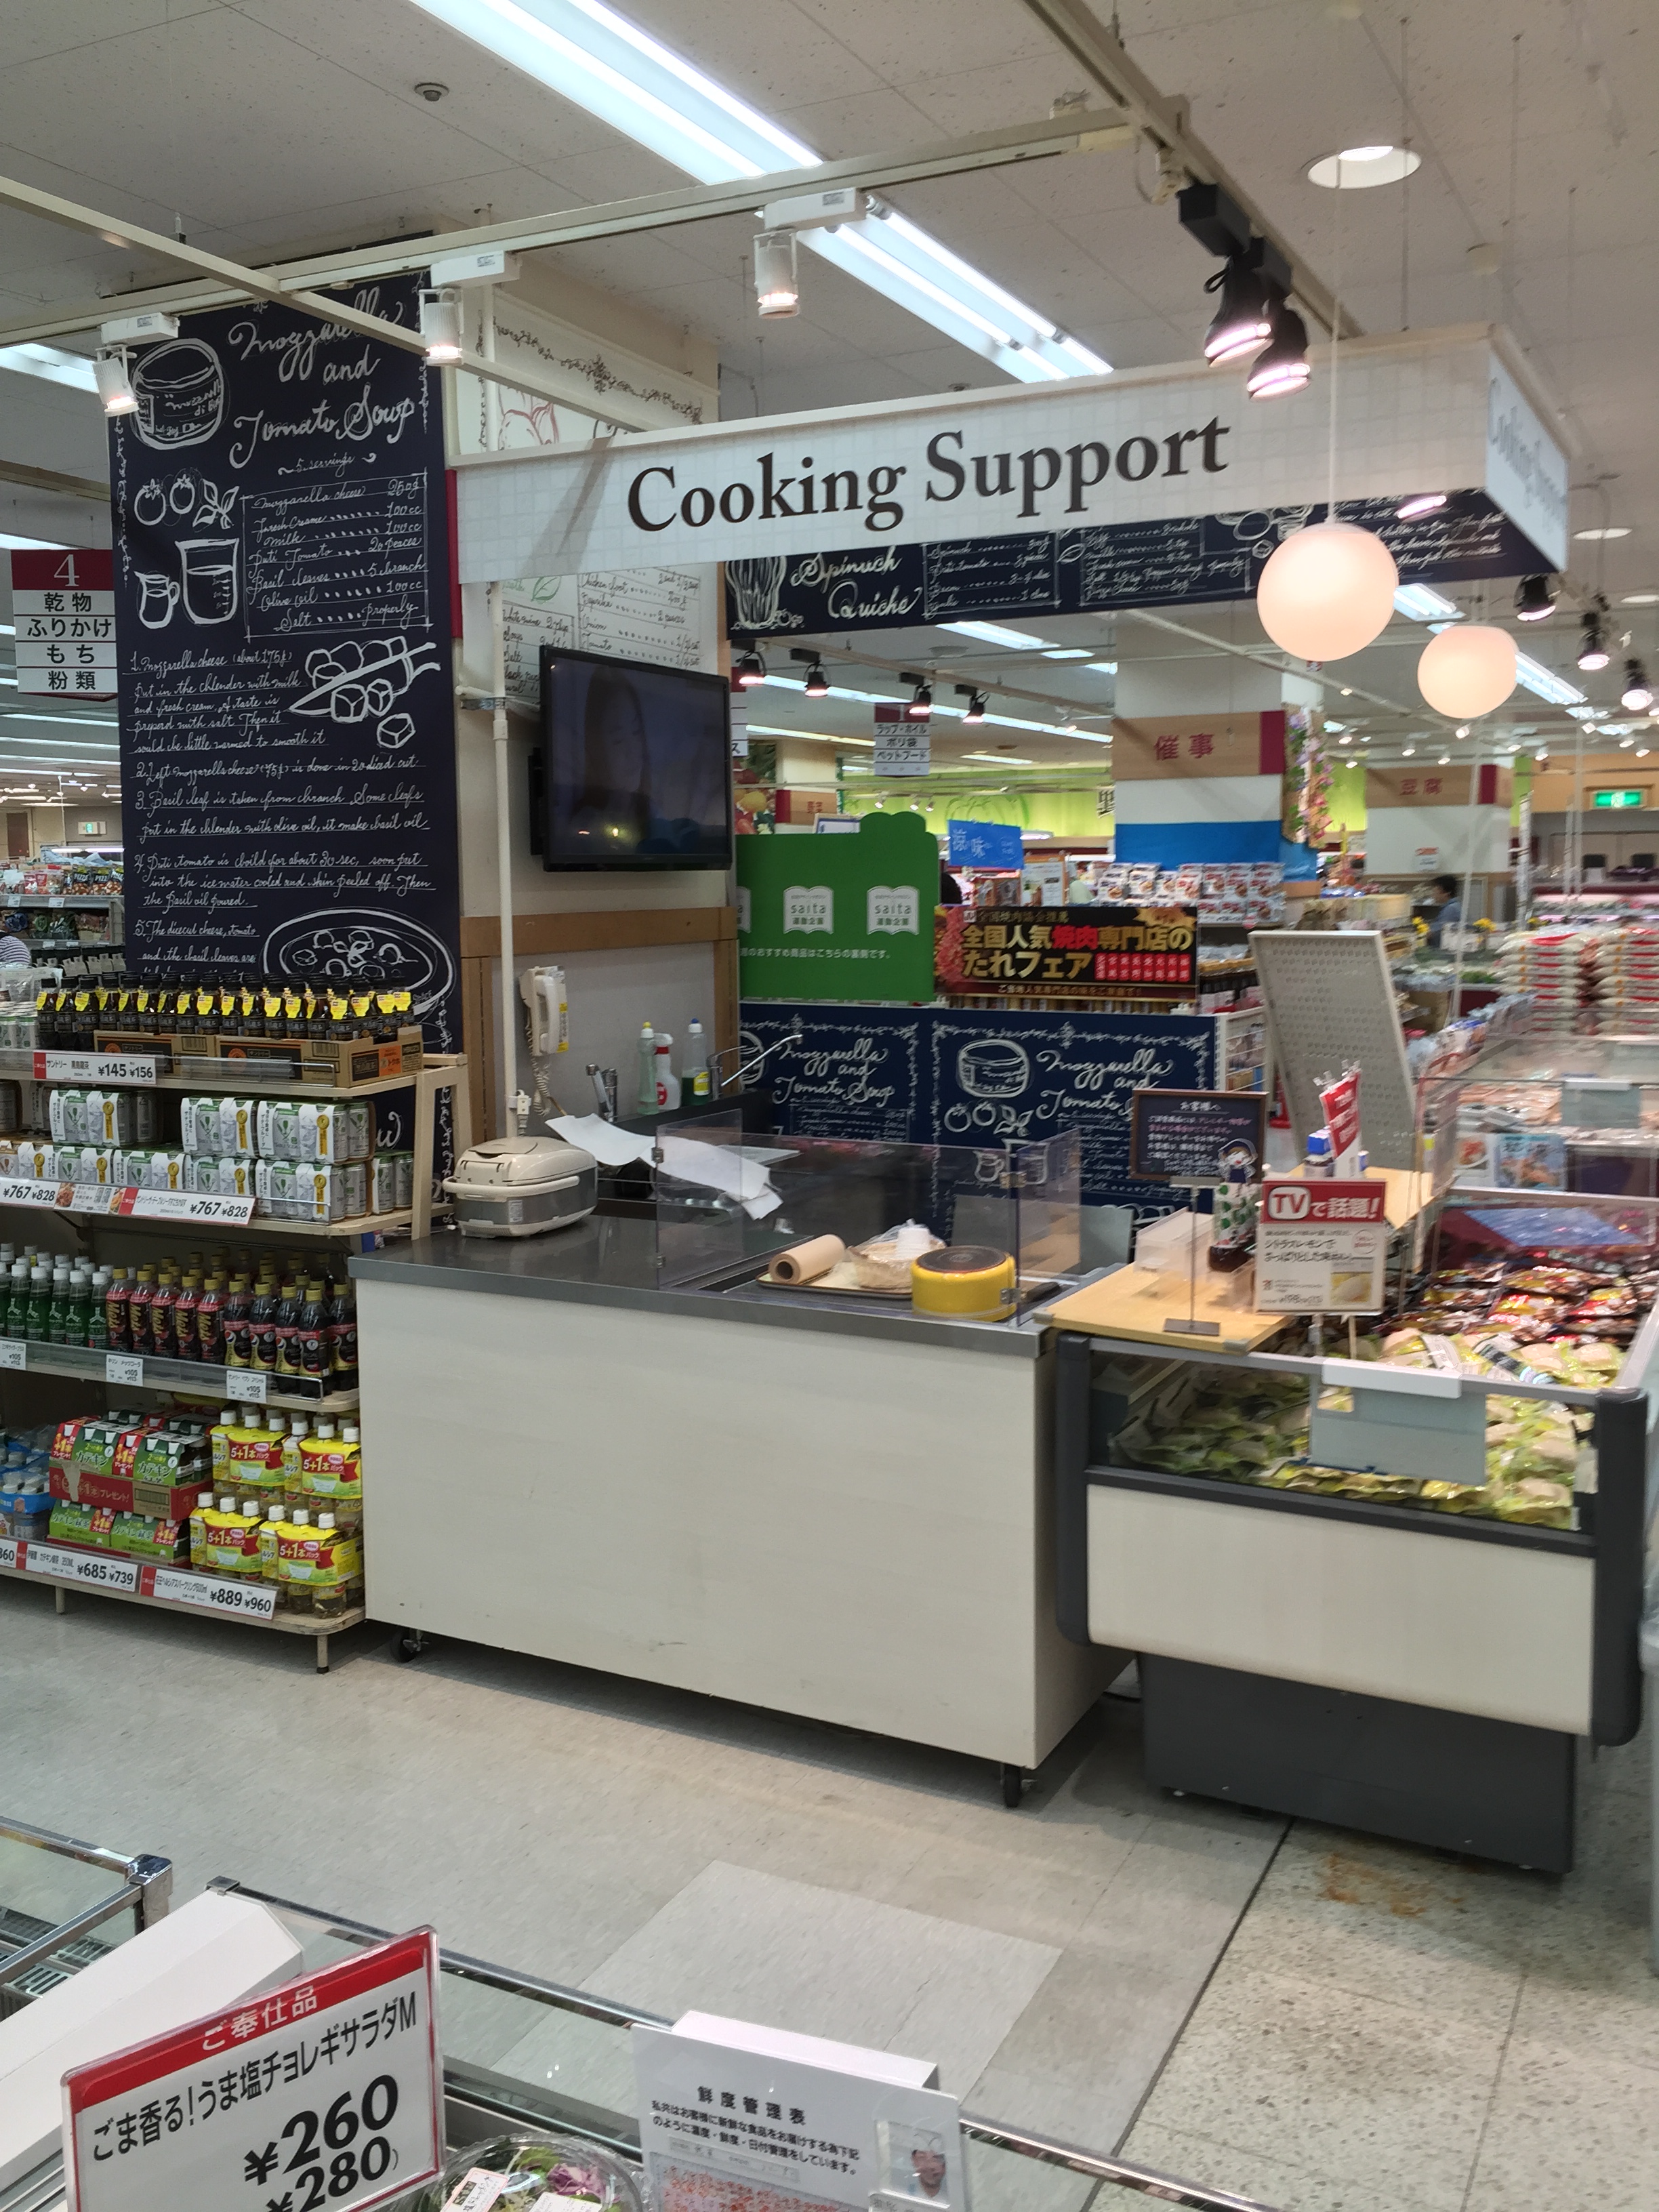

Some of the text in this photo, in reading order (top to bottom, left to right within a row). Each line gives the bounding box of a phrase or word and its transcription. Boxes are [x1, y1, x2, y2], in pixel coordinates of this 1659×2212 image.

[322, 344, 382, 386] and
[228, 398, 340, 469] Tomato
[335, 382, 415, 444] Soup
[628, 415, 1231, 531] Cooking Support
[285, 543, 333, 571] Tomato
[54, 554, 79, 587] 4
[246, 569, 285, 605] Basil
[827, 578, 922, 619] Quiche
[44, 592, 91, 612] 乾物
[261, 594, 292, 611] Olive
[27, 618, 111, 638] ふりかけ
[274, 608, 312, 632] Salt
[47, 644, 95, 664] もち
[48, 671, 96, 690] 粉類
[156, 684, 171, 696] in
[174, 676, 197, 694] the
[247, 672, 271, 689] with
[271, 670, 301, 688] milk
[134, 694, 280, 718] and fresh taste is
[177, 710, 281, 736] with Then it
[184, 732, 211, 750] little
[257, 735, 268, 747] to
[272, 730, 308, 745] smooth
[310, 729, 327, 744] it
[1154, 733, 1214, 761] 催事
[292, 760, 304, 772] is
[307, 757, 333, 771] done
[334, 758, 350, 771] in
[147, 788, 184, 818] Basil
[213, 792, 226, 803] is
[229, 791, 258, 804] taken
[260, 790, 295, 811] from
[350, 783, 386, 805] Some
[164, 821, 178, 834] in
[180, 818, 197, 834] the
[245, 818, 272, 833] with
[274, 816, 299, 831] olive
[323, 818, 335, 829] it
[338, 817, 369, 830] make
[404, 812, 428, 828] oil
[174, 855, 216, 867] tomato
[218, 853, 230, 865] is
[268, 853, 287, 874] for
[289, 852, 318, 865] about
[369, 856, 396, 865] soon
[394, 852, 422, 872] put
[149, 876, 173, 887] into
[178, 873, 197, 887] the
[200, 875, 216, 888] ice
[218, 877, 251, 888] water
[253, 872, 282, 887] cooled
[284, 873, 306, 886] and
[308, 872, 335, 886] skin
[396, 874, 432, 897] Then
[142, 891, 163, 905] the
[162, 890, 193, 914] Basil
[194, 891, 209, 905] oil
[790, 903, 827, 915] saita
[874, 903, 912, 915] saita
[146, 920, 166, 943] The
[228, 924, 256, 935] tomato
[962, 924, 1193, 951] 全国人気焼肉専門店の
[142, 947, 161, 960] and
[163, 946, 182, 960] the
[962, 951, 1093, 979] たれフェア
[47, 1060, 67, 1068] サントリー
[98, 1064, 127, 1077] ¥145
[129, 1067, 153, 1078] ¥156
[837, 1060, 878, 1076] and
[772, 1076, 896, 1108] Tomato Soup
[1036, 1088, 1123, 1119] Tomato
[3, 1185, 56, 1201] ¥767 ¥828
[190, 1201, 222, 1215] ¥767
[222, 1206, 249, 1218] ¥828
[1273, 1193, 1380, 1219] TVで話題!
[77, 1563, 134, 1584] ¥685 ¥739
[209, 1589, 271, 1612] ¥889 ¥960
[202, 1986, 317, 2051] ご奉仕品
[92, 1991, 416, 2161] ごま香る!うま塩チョレギサラダM
[698, 2086, 806, 2126] 鮮度管理表
[244, 2074, 398, 2186] ¥260
